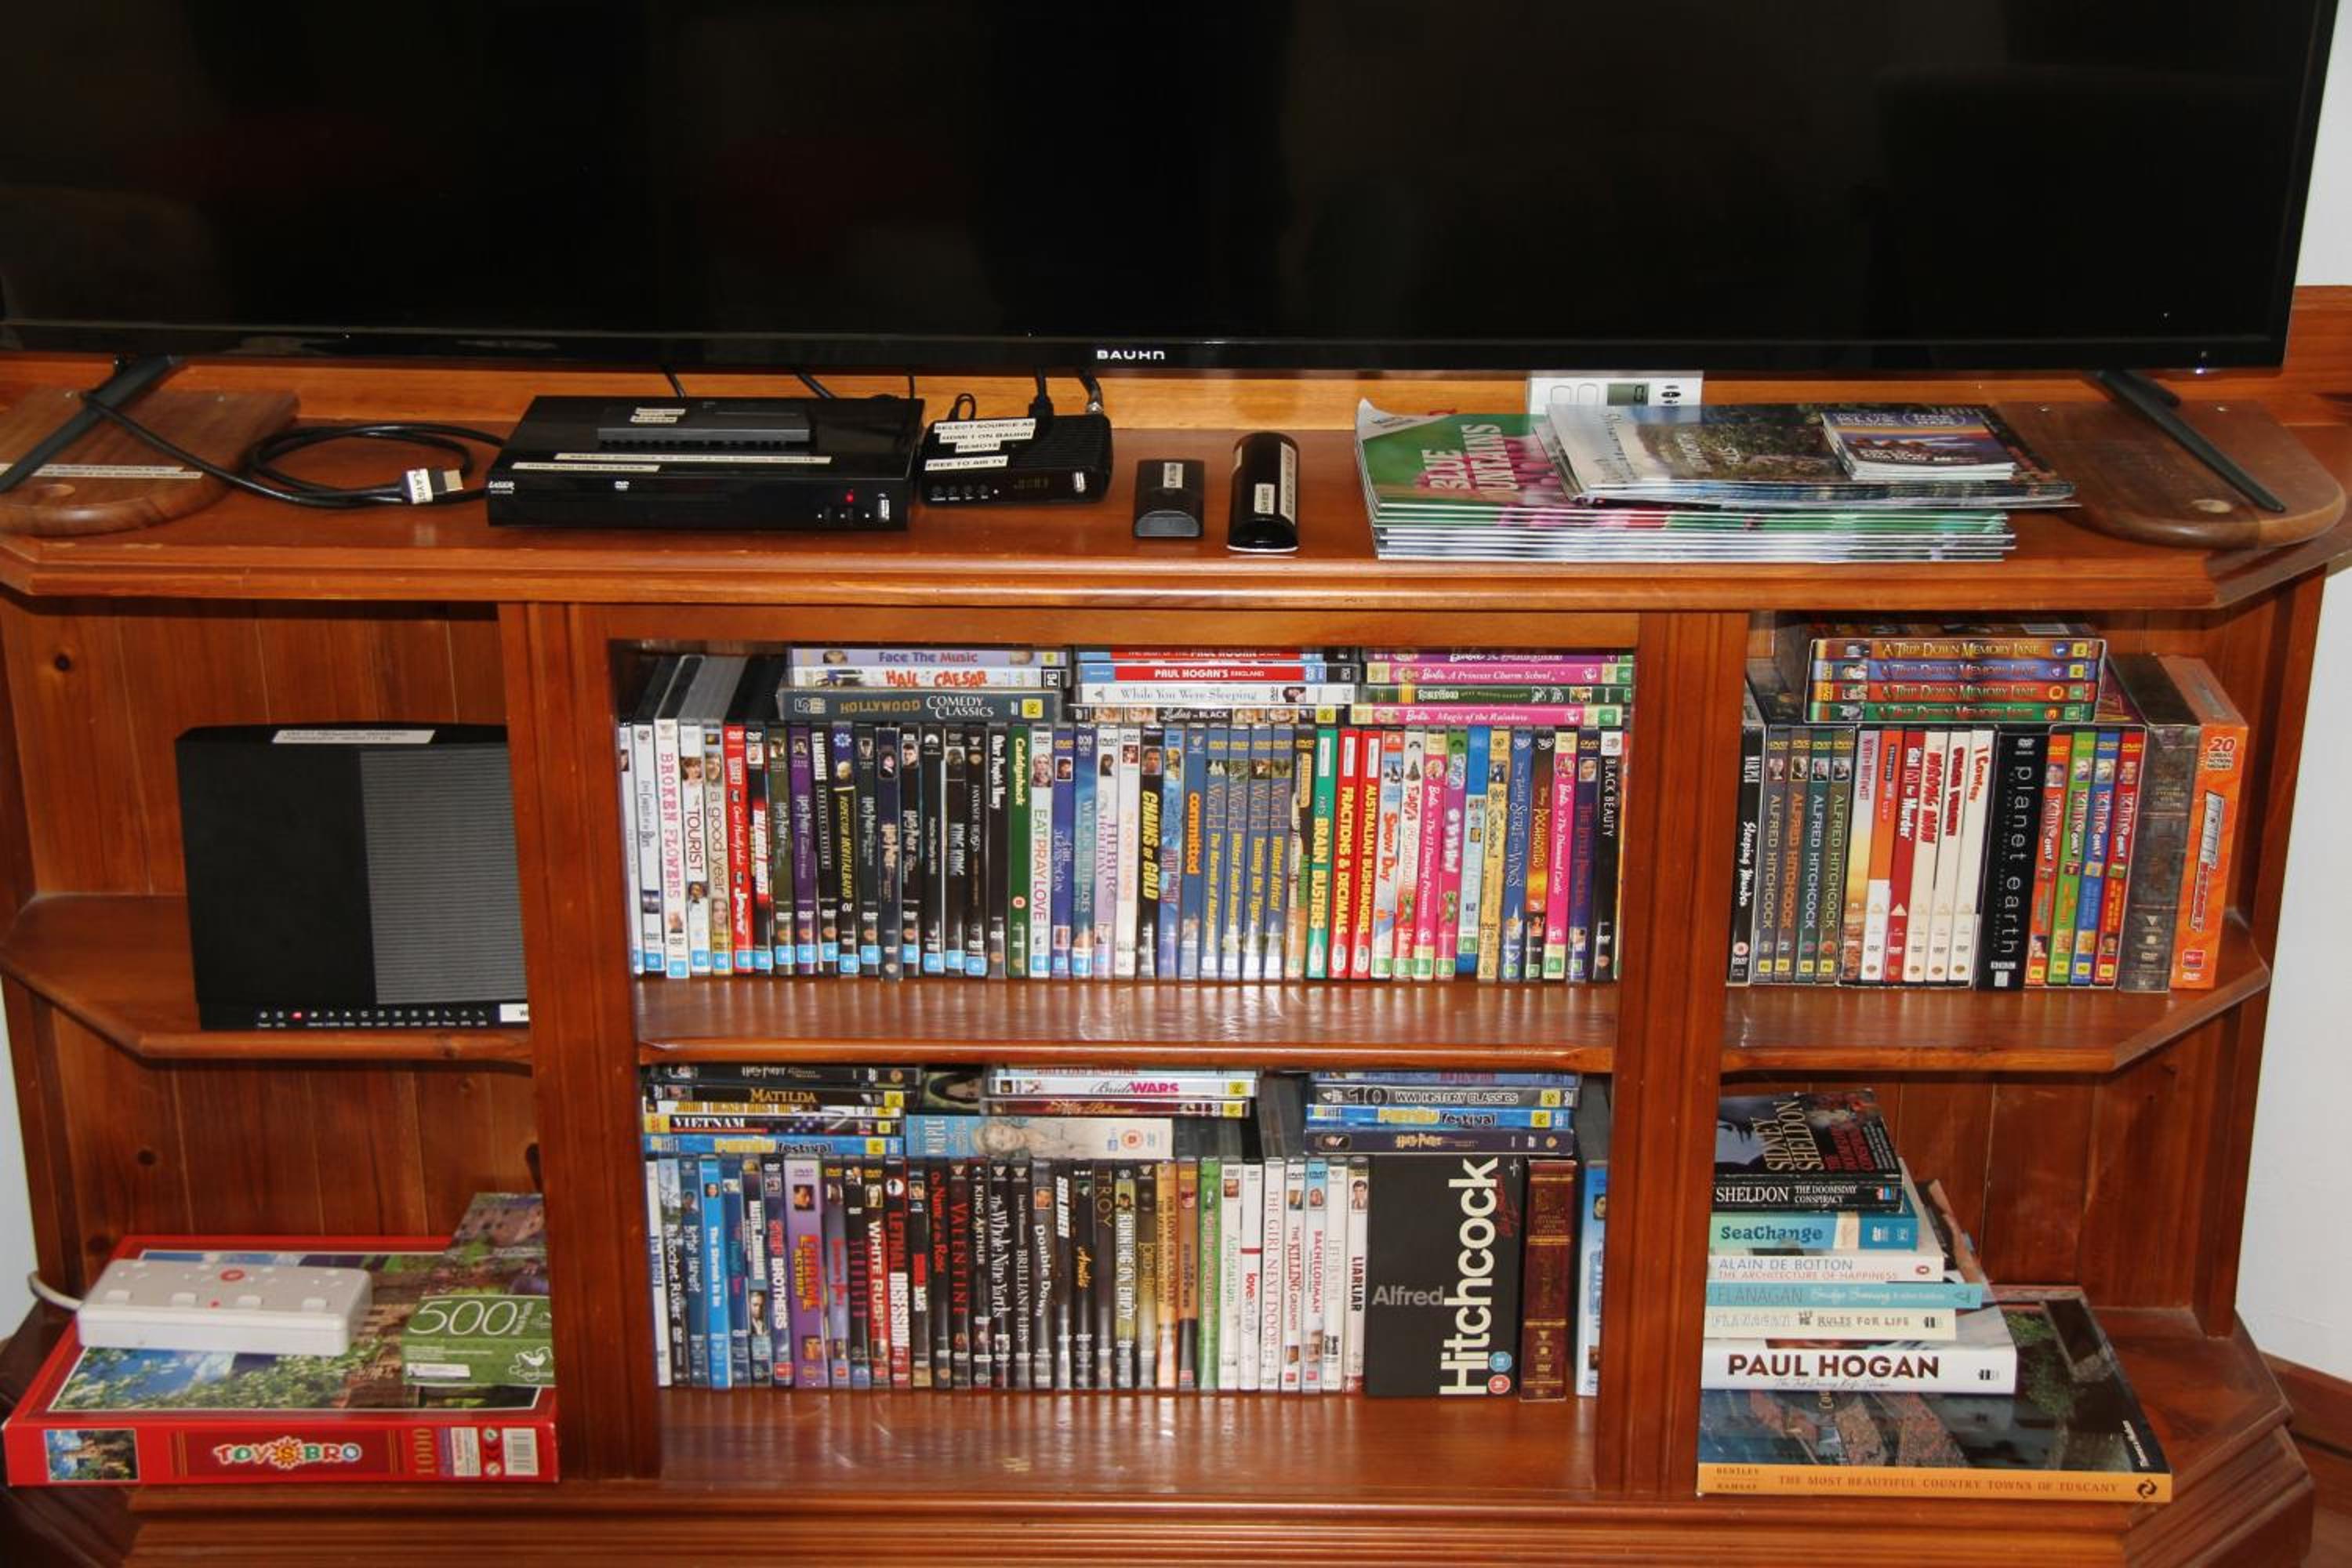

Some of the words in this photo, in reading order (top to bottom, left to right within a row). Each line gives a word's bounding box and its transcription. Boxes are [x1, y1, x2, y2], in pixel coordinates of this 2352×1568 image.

[879, 652, 909, 663] Face
[913, 652, 935, 662] The
[941, 652, 978, 662] Music
[1896, 643, 1920, 655] TRIP
[1924, 644, 1960, 655] DOWN
[1965, 642, 2009, 655] MEMORY
[2013, 643, 2039, 655] LANE
[886, 670, 919, 686] HAIL
[934, 670, 987, 686] CAESAR
[1182, 670, 1229, 678] HOGAN'S
[840, 699, 920, 713] HOLLYWOOD
[926, 695, 982, 708] COMEDY
[935, 705, 994, 718] CLASSICS
[1121, 688, 1153, 699] While
[1159, 688, 1175, 699] You
[1179, 688, 1206, 699] Were
[1208, 688, 1257, 701] Sleeping
[1200, 710, 1229, 719] BLACK
[1436, 712, 1465, 724] Magic
[992, 735, 1004, 756] Other
[2208, 737, 2235, 753] 20
[661, 753, 677, 822] BROKEN
[1013, 738, 1025, 806] Caddyshack
[1605, 758, 1616, 793] BLACK
[1923, 752, 1943, 807] WRONG
[711, 790, 720, 802] a
[990, 787, 1004, 809] Money
[1207, 782, 1225, 829] World
[1229, 782, 1245, 829] World
[1250, 782, 1268, 829] World
[1272, 782, 1288, 829] World
[2006, 766, 2034, 861] planet
[710, 807, 726, 852] good
[840, 796, 849, 835] INSPECTOR
[1034, 808, 1047, 838] EAT
[1142, 790, 1159, 846] CHAINS
[1186, 793, 1200, 875] committed
[1338, 786, 1354, 857] FRACTIONS
[1363, 784, 1376, 857] AUSTRALIAN
[1602, 796, 1615, 837] BEAUTY
[1767, 794, 1781, 848] ALFRED
[1810, 794, 1824, 848] ALFRED
[1831, 794, 1845, 848] ALFRED
[687, 808, 703, 873] TOURIST
[949, 823, 964, 847] KING
[1313, 818, 1329, 863] BRAIN
[1533, 808, 1548, 867] POCAHONTAS
[1555, 836, 1565, 869] Diamond
[1740, 821, 1756, 866] Sleeping
[2044, 838, 2053, 860] ONLY
[2070, 832, 2080, 856] ONLY
[2092, 833, 2102, 856] ONLY
[2116, 836, 2125, 859] ONLY
[664, 829, 681, 899] FLOWERS
[841, 836, 852, 898] MONTALBANO
[949, 849, 964, 877] KONG
[1034, 839, 1047, 880] PRAY
[1271, 836, 1283, 876] Wildest
[1339, 859, 1352, 868] &
[712, 858, 727, 893] year
[1143, 861, 1159, 900] GOLD
[1763, 852, 1779, 929] HITCHCOCK
[1805, 852, 1820, 929] HITCHCOCK
[1826, 852, 1841, 929] HITCHCOCK
[1034, 880, 1047, 921] LOVE
[1311, 870, 1327, 929] BUSTERS
[1336, 872, 1350, 935] DECIMALS
[1358, 858, 1373, 935] BUSHRANGERS
[2001, 876, 2022, 953] earth
[750, 1088, 816, 1102] MATILDA
[1131, 1082, 1179, 1094] WARS
[1348, 1087, 1390, 1104] 10
[1468, 1091, 1519, 1104] CLASSICS
[670, 1116, 746, 1128] VIETNAM
[1773, 1100, 1825, 1171] SHELDON
[975, 1185, 985, 1214] KING
[990, 1195, 1001, 1210] The
[1056, 1175, 1069, 1239] SOLDIER
[1096, 1171, 1112, 1227] TROY
[1269, 1191, 1278, 1214] THE
[1715, 1185, 1789, 1203] SHELDON
[1795, 1185, 1810, 1194] THE
[1810, 1185, 1857, 1194] DOOMSDAY
[1795, 1194, 1845, 1204] CONSPIRACY
[868, 1221, 882, 1274] WHITE
[888, 1211, 906, 1269] LETHAL
[973, 1217, 986, 1266] ARTHUR
[990, 1210, 1011, 1251] Whole
[1118, 1214, 1133, 1264] RUNNING
[1167, 1215, 1177, 1242] LOVE
[1267, 1219, 1279, 1254] GIRL
[1720, 1225, 1824, 1243] SeaChange
[665, 1224, 681, 1281] Ricochet
[952, 1203, 968, 1316] VALENTINE
[991, 1254, 1010, 1284] Nine
[1033, 1224, 1051, 1276] Double
[1287, 1243, 1301, 1292] KILLING
[1719, 1259, 1763, 1270] ALAIN
[1769, 1259, 1788, 1270] DE
[1795, 1259, 1853, 1270] BOTTON
[794, 1249, 804, 1297] ACTION
[1016, 1249, 1029, 1312] BRILLIANT
[1120, 1268, 1132, 1282] ON
[1245, 1272, 1257, 1298] love
[1266, 1258, 1279, 1299] NEXT
[1352, 1256, 1364, 1285] LIAR
[1439, 1157, 1498, 1395] Hitchcock
[1719, 1271, 1738, 1280] THE
[1741, 1271, 1818, 1280] ARCHITECTURE
[1822, 1271, 1837, 1280] OF
[1840, 1271, 1898, 1280] HAPPINESS
[670, 1283, 683, 1320] River
[772, 1258, 788, 1329] BROTHERS
[890, 1272, 910, 1347] OBSESSION
[991, 1283, 1011, 1318] Yards
[1035, 1280, 1051, 1317] Down
[1119, 1287, 1133, 1320] EMPTY
[1351, 1285, 1363, 1312] LIAR
[1372, 1285, 1443, 1305] Alfred
[408, 1300, 517, 1335] 500
[1265, 1301, 1278, 1348] DOOR
[1818, 1317, 1852, 1327] RULES
[1857, 1317, 1879, 1327] FOR
[1885, 1318, 1909, 1327] LIFE
[1726, 1353, 1809, 1377] PAUL
[1817, 1356, 1940, 1380] HOGAN
[1779, 1475, 1801, 1486] THE
[1805, 1475, 1842, 1487] MOST
[1847, 1476, 1918, 1489] BEAUTIFUL
[1922, 1479, 1982, 1490] COUNTRY
[1987, 1480, 2033, 1491] TOWNS
[2037, 1481, 2056, 1491] OF
[2059, 1481, 2120, 1494] TUSCANY
